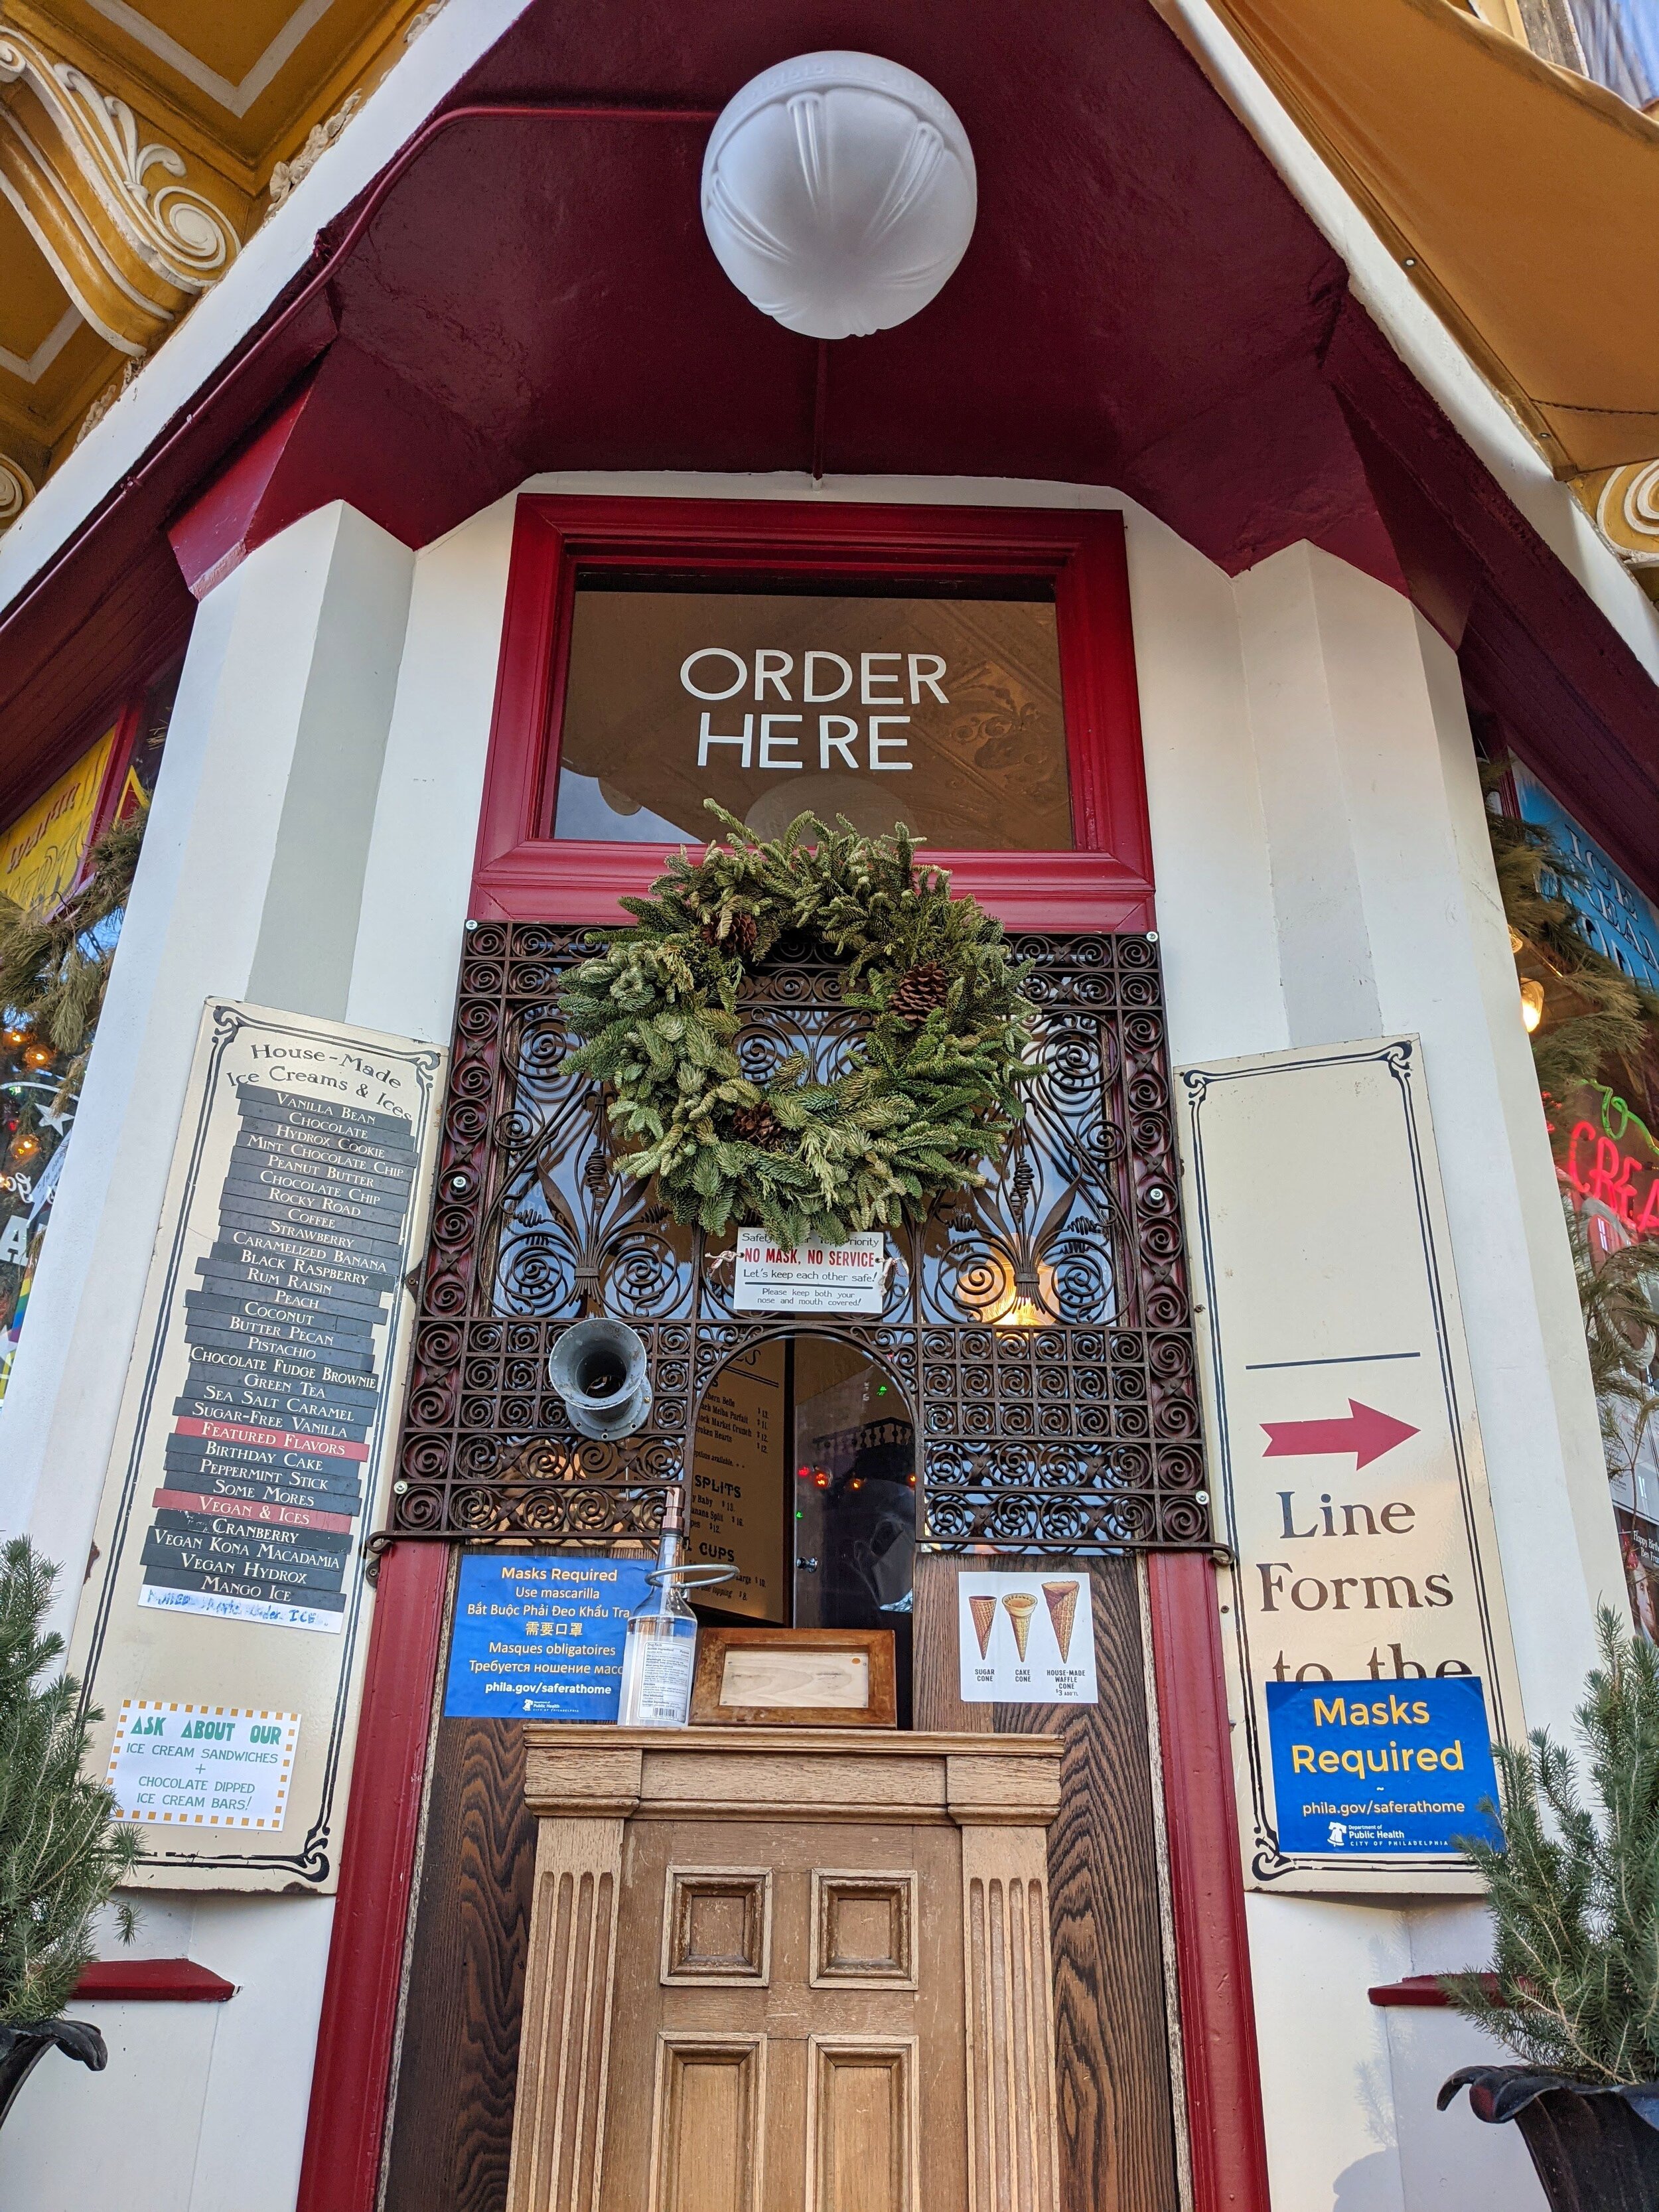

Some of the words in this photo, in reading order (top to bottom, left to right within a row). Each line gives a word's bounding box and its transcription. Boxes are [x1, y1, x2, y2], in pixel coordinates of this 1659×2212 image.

[680, 648, 950, 704] ORDER
[697, 712, 913, 769] HERE
[226, 1072, 259, 1087] Ice
[269, 1065, 348, 1091] Creams
[356, 1084, 368, 1098] &
[376, 1092, 412, 1120] Ices
[276, 1092, 333, 1116] VANILLA
[341, 1106, 376, 1125] BEAN
[289, 1112, 368, 1139] CHOCOLATE
[275, 1124, 330, 1147] HYDROX
[337, 1138, 385, 1158] COOKIE
[247, 1135, 283, 1153] MINT
[290, 1143, 366, 1170] CHOCOLATE
[374, 1161, 404, 1177] CHIP
[267, 1155, 320, 1176] PEANUT
[326, 1168, 374, 1187] BUTTER
[259, 1171, 341, 1197] CHOCOLATE
[348, 1188, 380, 1205] CHIP
[268, 1187, 315, 1209] ROCKY
[321, 1197, 361, 1217] ROAD
[287, 1209, 336, 1228] COFFEE
[269, 1220, 355, 1248] STRAWBERRY
[233, 1231, 326, 1259] CARAMELIZED
[334, 1250, 387, 1272] BANANA
[745, 1248, 760, 1262] NO
[766, 1248, 801, 1265] MASK,
[808, 1250, 822, 1264] NO
[830, 1250, 874, 1267] SERVICE
[240, 1249, 286, 1270] BLACK
[293, 1259, 369, 1286] RASPBERRY
[743, 1268, 768, 1278] Let's
[771, 1270, 793, 1280] keep
[796, 1270, 818, 1280] each
[822, 1272, 846, 1281] other
[851, 1272, 877, 1282] safe!
[247, 1268, 279, 1285] RUM
[287, 1276, 332, 1295] RAISIN
[792, 1288, 810, 1297] keep
[244, 1301, 315, 1325] COCONUT
[274, 1290, 319, 1309] PEACH
[230, 1315, 281, 1337] BUTTER
[289, 1326, 334, 1347] PECAN
[247, 1337, 316, 1360] PISTACHIO
[191, 1347, 267, 1371] CHOCOLATE
[273, 1360, 316, 1379] FUDGE
[323, 1367, 377, 1389] BROWNIE
[244, 1373, 292, 1392] GREEN
[300, 1382, 326, 1398] TEA
[203, 1385, 233, 1402] SEA
[241, 1390, 279, 1408] SALT
[286, 1398, 354, 1422] CARAMEL
[192, 1401, 283, 1428] SUGAR-FREE
[292, 1416, 348, 1438] VANILLA
[711, 1416, 731, 1431] Market
[733, 1424, 752, 1437] Crunch
[201, 1422, 277, 1445] FEATURED
[283, 1434, 346, 1455] FLAVORS
[715, 1430, 732, 1443] Hearts
[204, 1441, 277, 1465] BIRTHDAY
[283, 1453, 323, 1471] CAKE
[199, 1459, 283, 1483] PEPPERMINT
[289, 1471, 328, 1491] STICK
[695, 1475, 741, 1499] SPLITS
[213, 1479, 255, 1498] SOME
[263, 1486, 315, 1507] MORES
[697, 1495, 713, 1507] Baby
[200, 1496, 252, 1516] VEGAN
[259, 1505, 271, 1519] &
[279, 1507, 310, 1524] ICES
[710, 1510, 723, 1522] Split
[1275, 1491, 1415, 1539] Line
[212, 1518, 299, 1544] CRANBERRY
[154, 1528, 204, 1549] VEGAN
[209, 1536, 250, 1555] KONA
[257, 1544, 340, 1569] MACADAMIA
[699, 1542, 735, 1562] CUPS
[181, 1552, 235, 1574] VEGAN
[244, 1562, 307, 1584] HYDROX
[502, 1567, 547, 1580] Masks
[551, 1569, 617, 1583] Required
[201, 1576, 261, 1597] MANGO
[269, 1585, 291, 1602] ICE
[516, 1587, 538, 1598] Use
[541, 1587, 600, 1599] mascarilla
[1256, 1562, 1454, 1611] Forms
[467, 1601, 487, 1615] Bắt
[523, 1603, 548, 1617] Phải
[526, 1621, 583, 1637] 需要口罩
[488, 1642, 543, 1657] Masques
[545, 1643, 616, 1658] obligatoires
[469, 1660, 530, 1675] Требуется
[534, 1663, 591, 1674] ношение
[485, 1682, 612, 1695] phila.gov/saferathome
[1313, 1694, 1429, 1726] Masks
[130, 1716, 167, 1736] ASK
[180, 1720, 236, 1741] ABOUT
[250, 1725, 281, 1745] OUR
[126, 1743, 145, 1754] ICE
[152, 1745, 194, 1758] CREAM
[200, 1749, 278, 1763] SANDWICHES
[1291, 1739, 1464, 1779] Required
[139, 1776, 208, 1791] CHOCOLATE
[214, 1781, 255, 1793] DIPPED
[137, 1793, 155, 1804] ICE
[162, 1795, 205, 1807] CREAM
[211, 1796, 252, 1810] BARS!
[1303, 1801, 1465, 1816] phila.gov/saferathome
